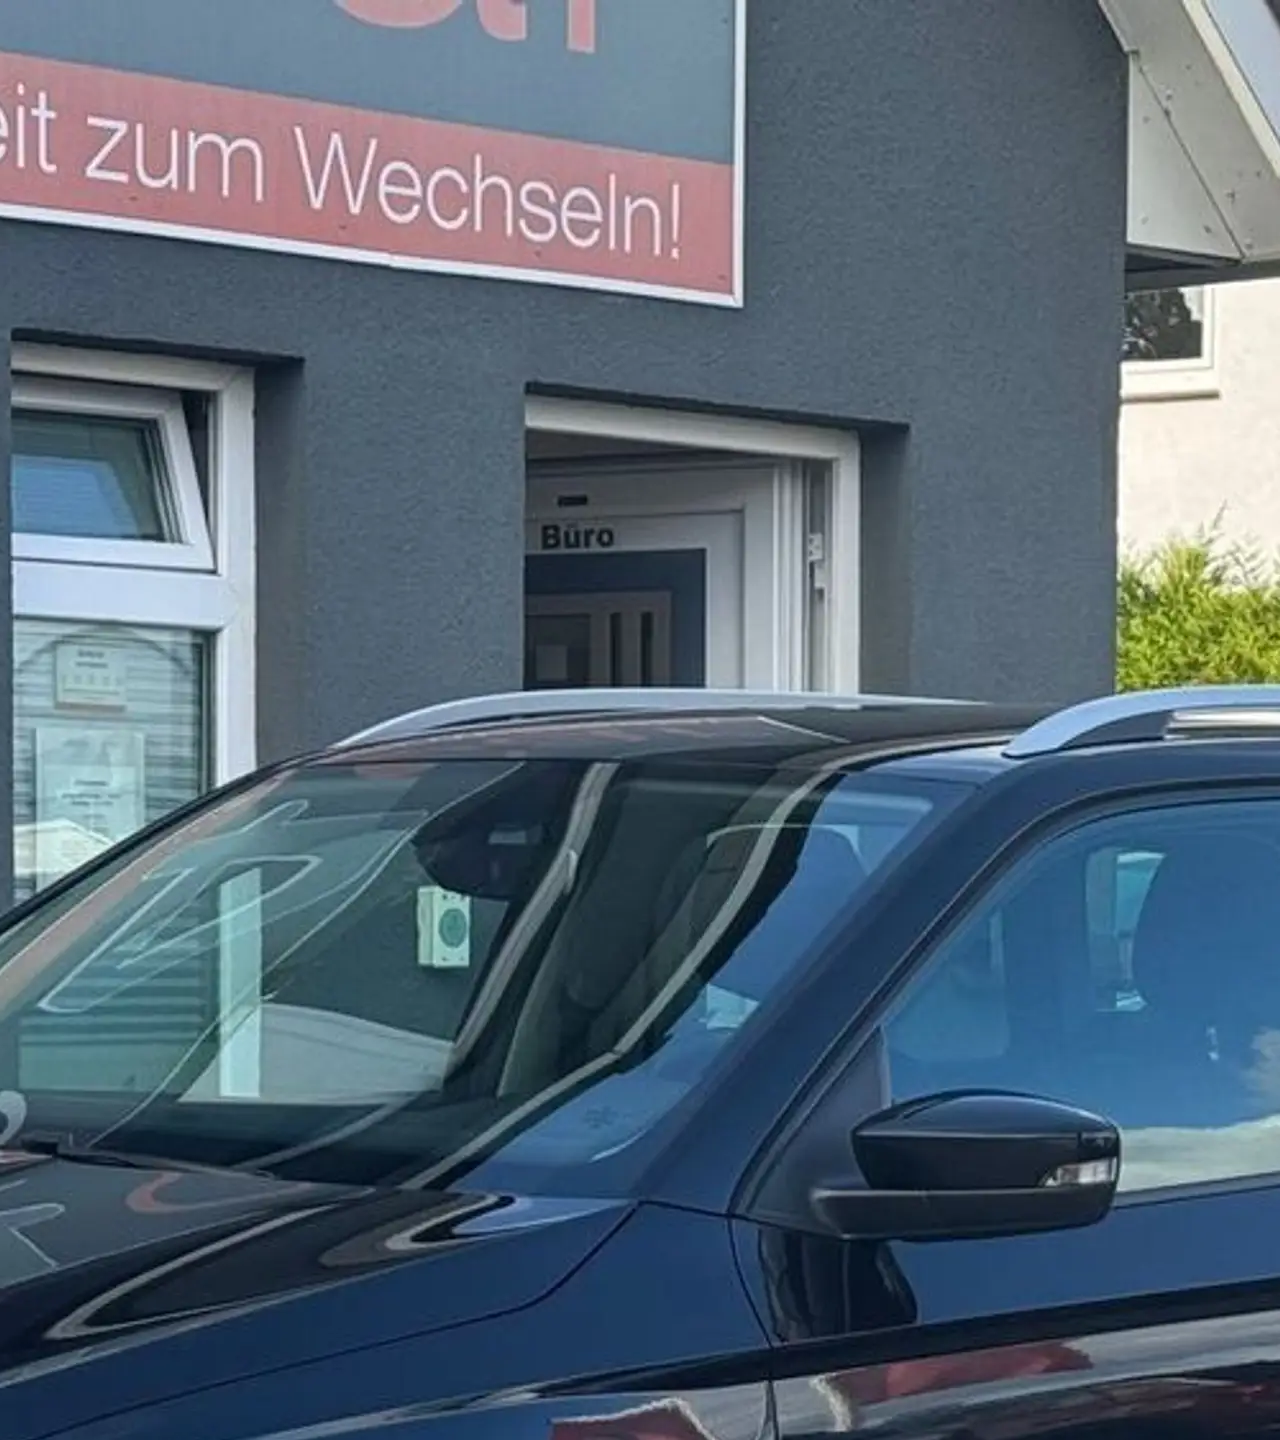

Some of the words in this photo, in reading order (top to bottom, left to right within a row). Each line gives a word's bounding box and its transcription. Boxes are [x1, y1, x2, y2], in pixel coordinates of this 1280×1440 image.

[84, 114, 265, 203] zum
[293, 125, 683, 261] Wechseln!
[541, 523, 615, 550] Büro
